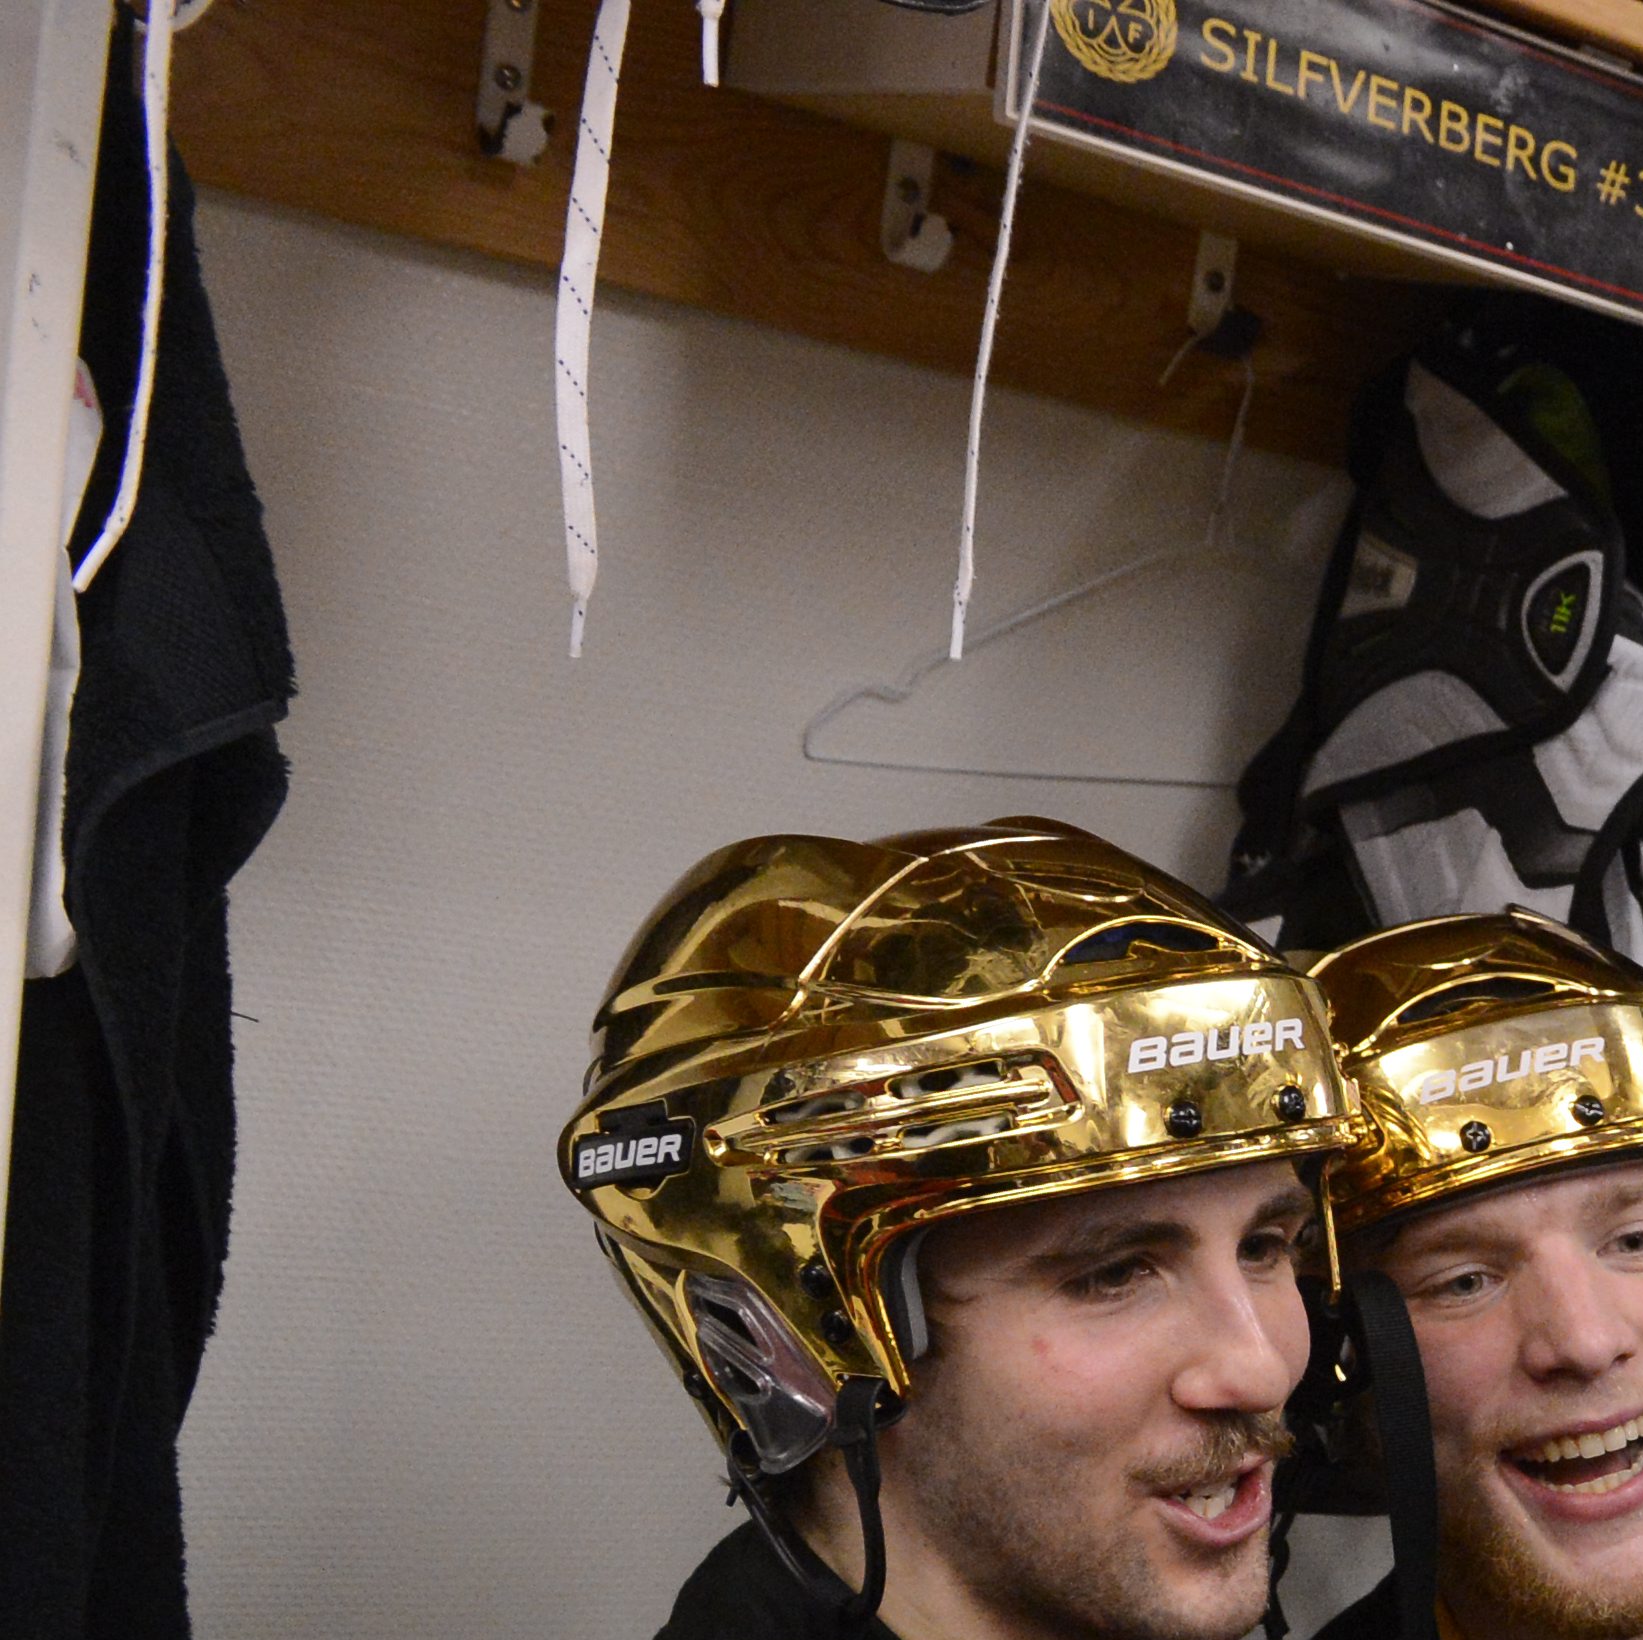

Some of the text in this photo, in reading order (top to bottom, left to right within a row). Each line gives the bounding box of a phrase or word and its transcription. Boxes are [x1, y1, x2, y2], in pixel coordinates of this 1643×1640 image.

[1200, 17, 1578, 193] SILFVERBERG
[1128, 1016, 1305, 1074] BAUER
[1419, 1035, 1606, 1105] BAUER
[577, 1132, 683, 1179] BAUER
